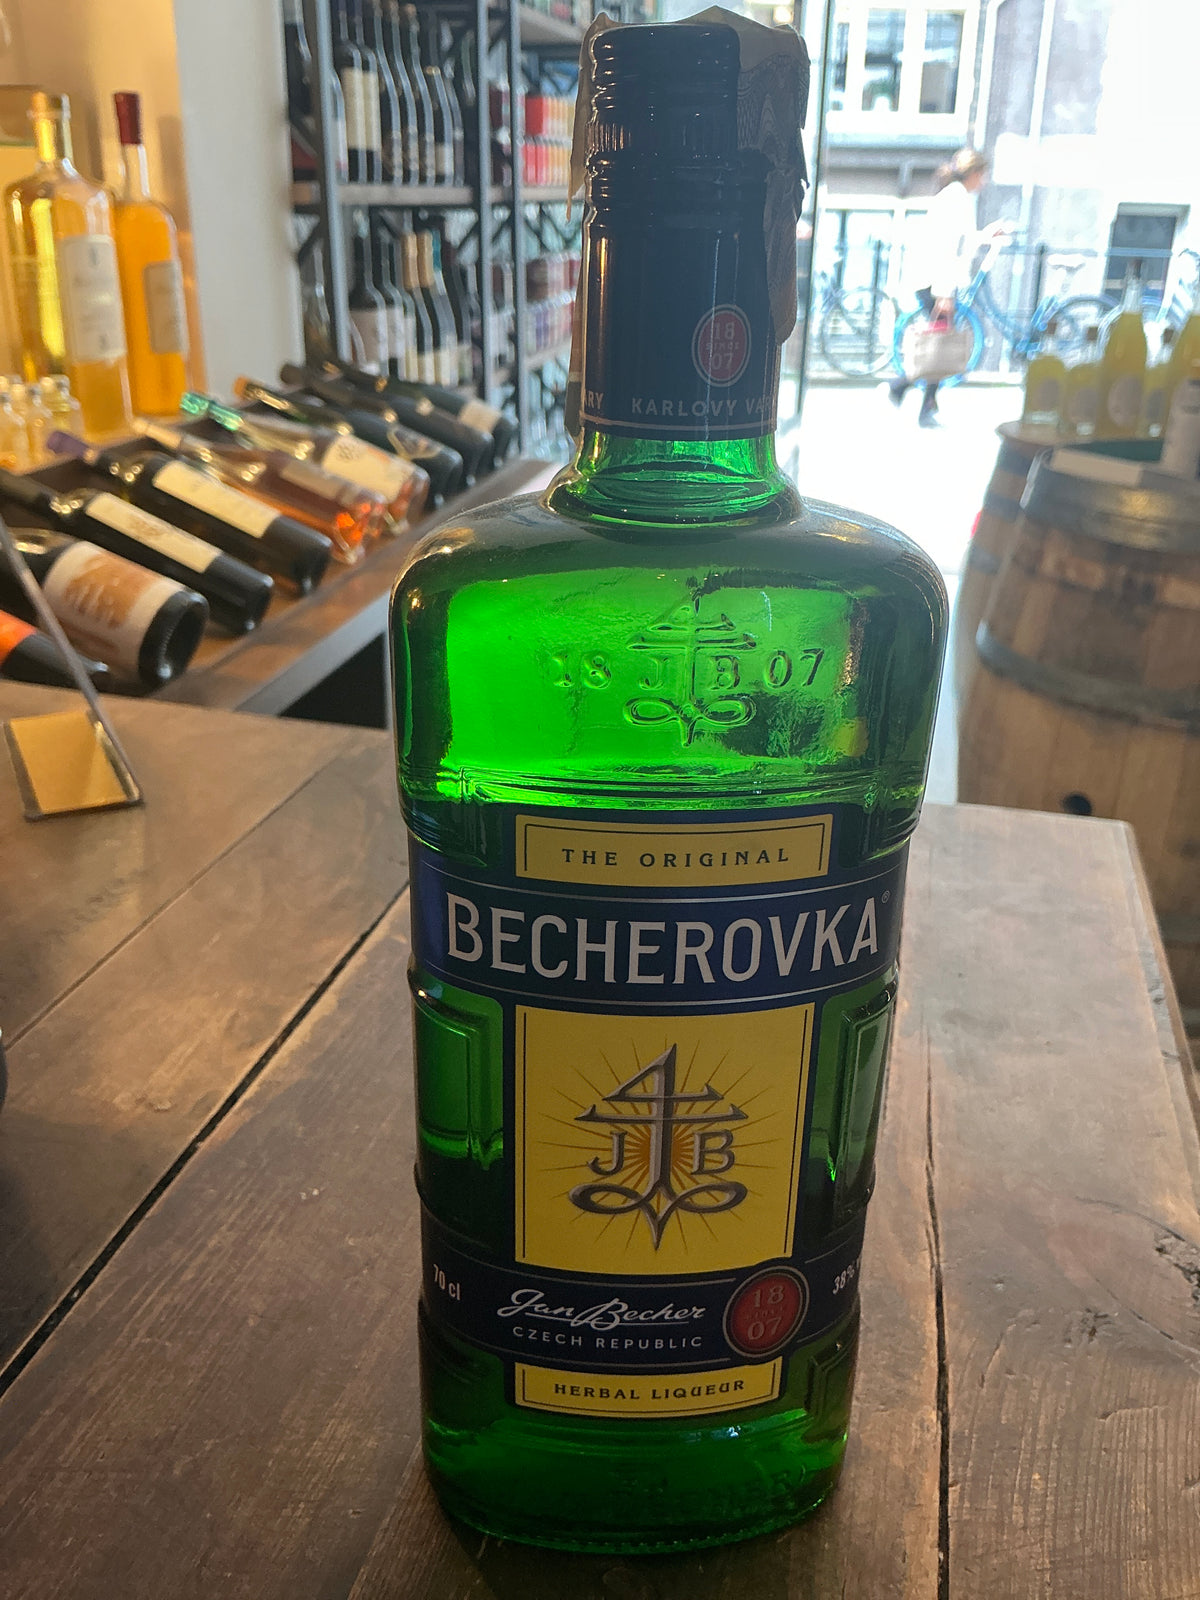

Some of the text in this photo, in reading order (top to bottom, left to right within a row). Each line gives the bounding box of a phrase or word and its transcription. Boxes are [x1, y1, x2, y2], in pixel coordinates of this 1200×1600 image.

[713, 322, 736, 340] 18
[711, 352, 733, 370] 07
[632, 397, 738, 417] KARLOVY
[553, 654, 612, 689] 18
[764, 648, 824, 688] 07
[561, 848, 789, 868] THE ORIGINAL
[446, 892, 879, 985] BECHEROVKA
[433, 1263, 461, 1301] 70 cl
[752, 1285, 786, 1308] 18
[497, 1288, 706, 1331] Jan Becher
[513, 1326, 702, 1350] CZECH REPUBLIC
[747, 1317, 782, 1340] 07
[554, 1379, 745, 1400] HERBAL LIQUEUR
